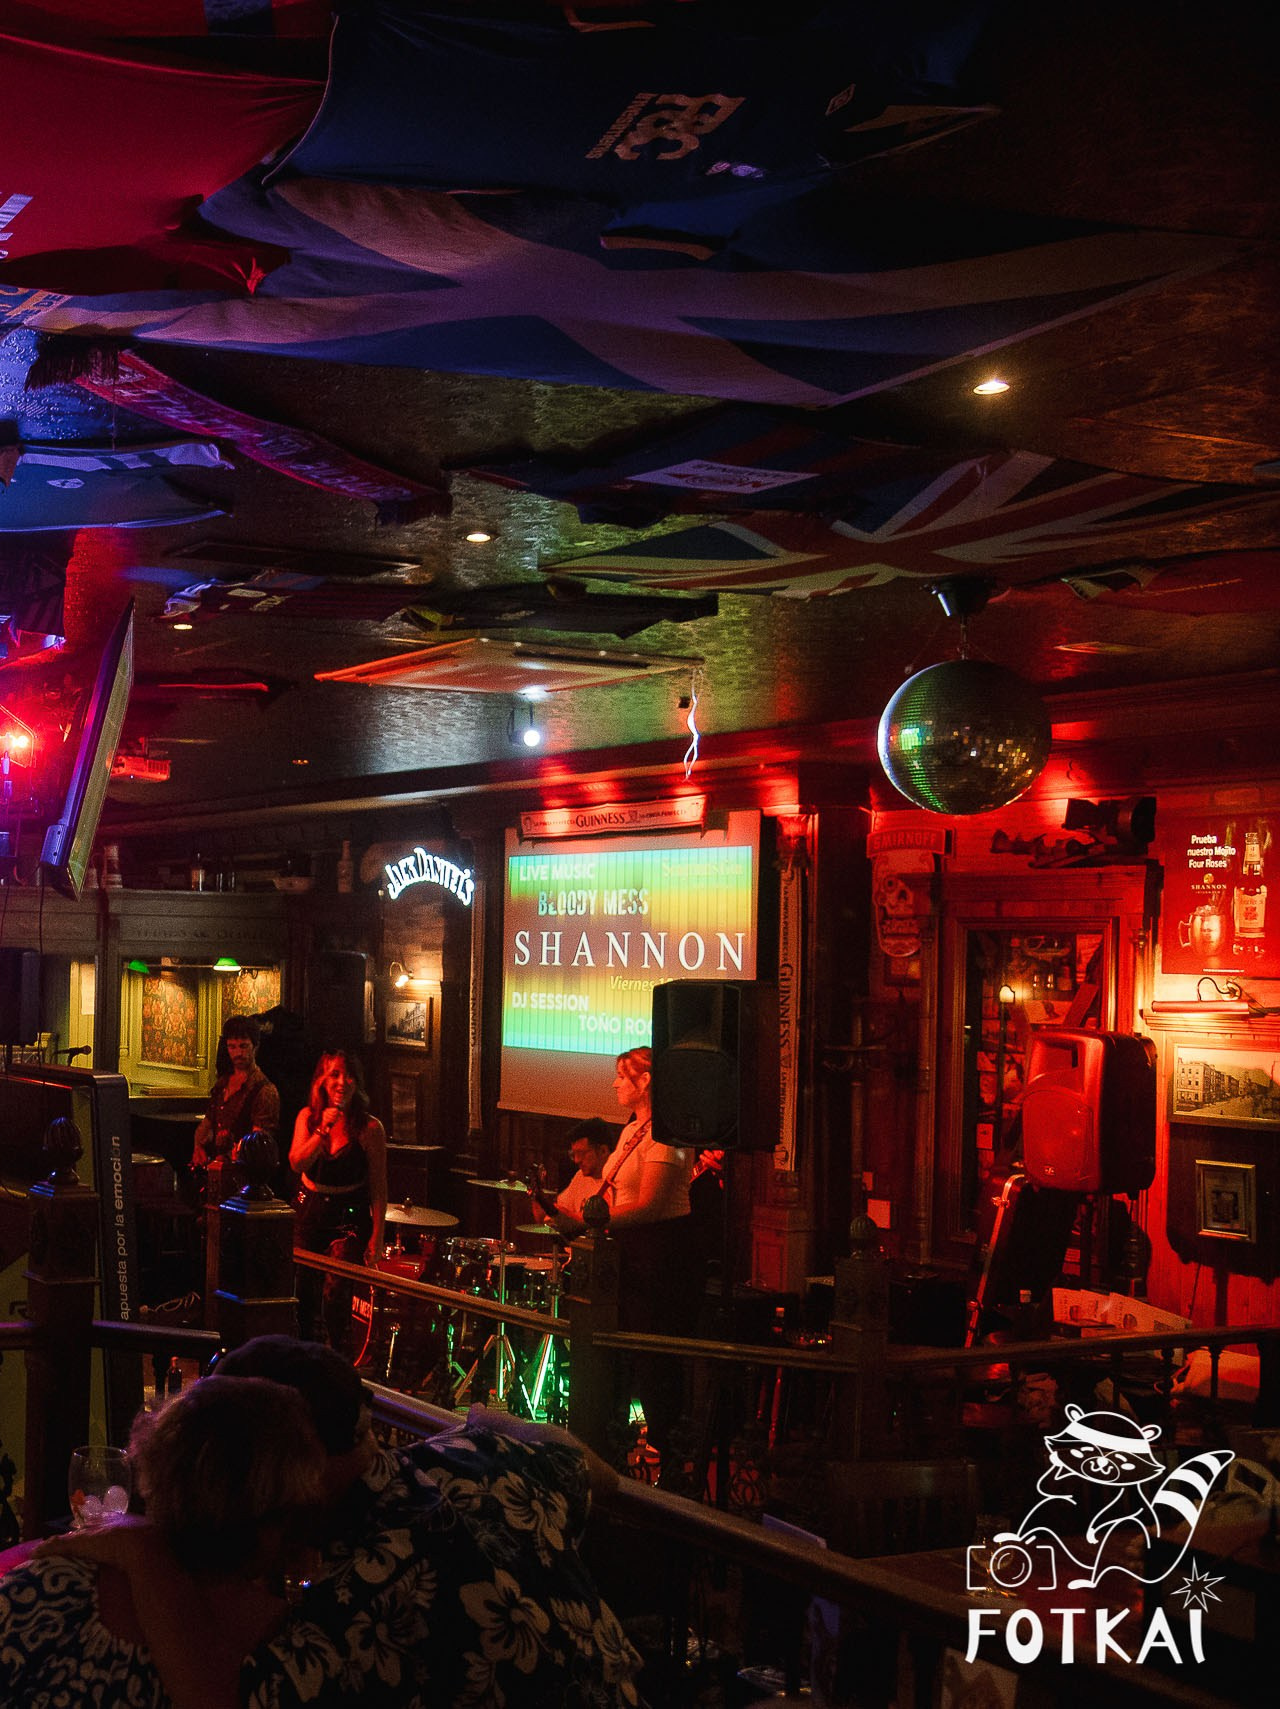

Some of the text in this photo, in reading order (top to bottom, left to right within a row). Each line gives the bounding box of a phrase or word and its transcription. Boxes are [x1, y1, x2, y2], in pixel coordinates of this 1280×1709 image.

[575, 811, 626, 828] GUINNESS
[1190, 834, 1218, 844] Prueba
[1186, 845, 1237, 857] nuestro Mojito
[519, 863, 596, 881] LIVE MUSIC
[1188, 858, 1228, 868] Four Roses
[537, 888, 650, 916] BLOODY MESS
[513, 930, 746, 972] SHANNON
[609, 975, 655, 992] Viernes
[511, 991, 590, 1012] DJ SESSION
[778, 963, 795, 1048] GUINNESS
[109, 1135, 132, 1321] apuesta por la emocin
